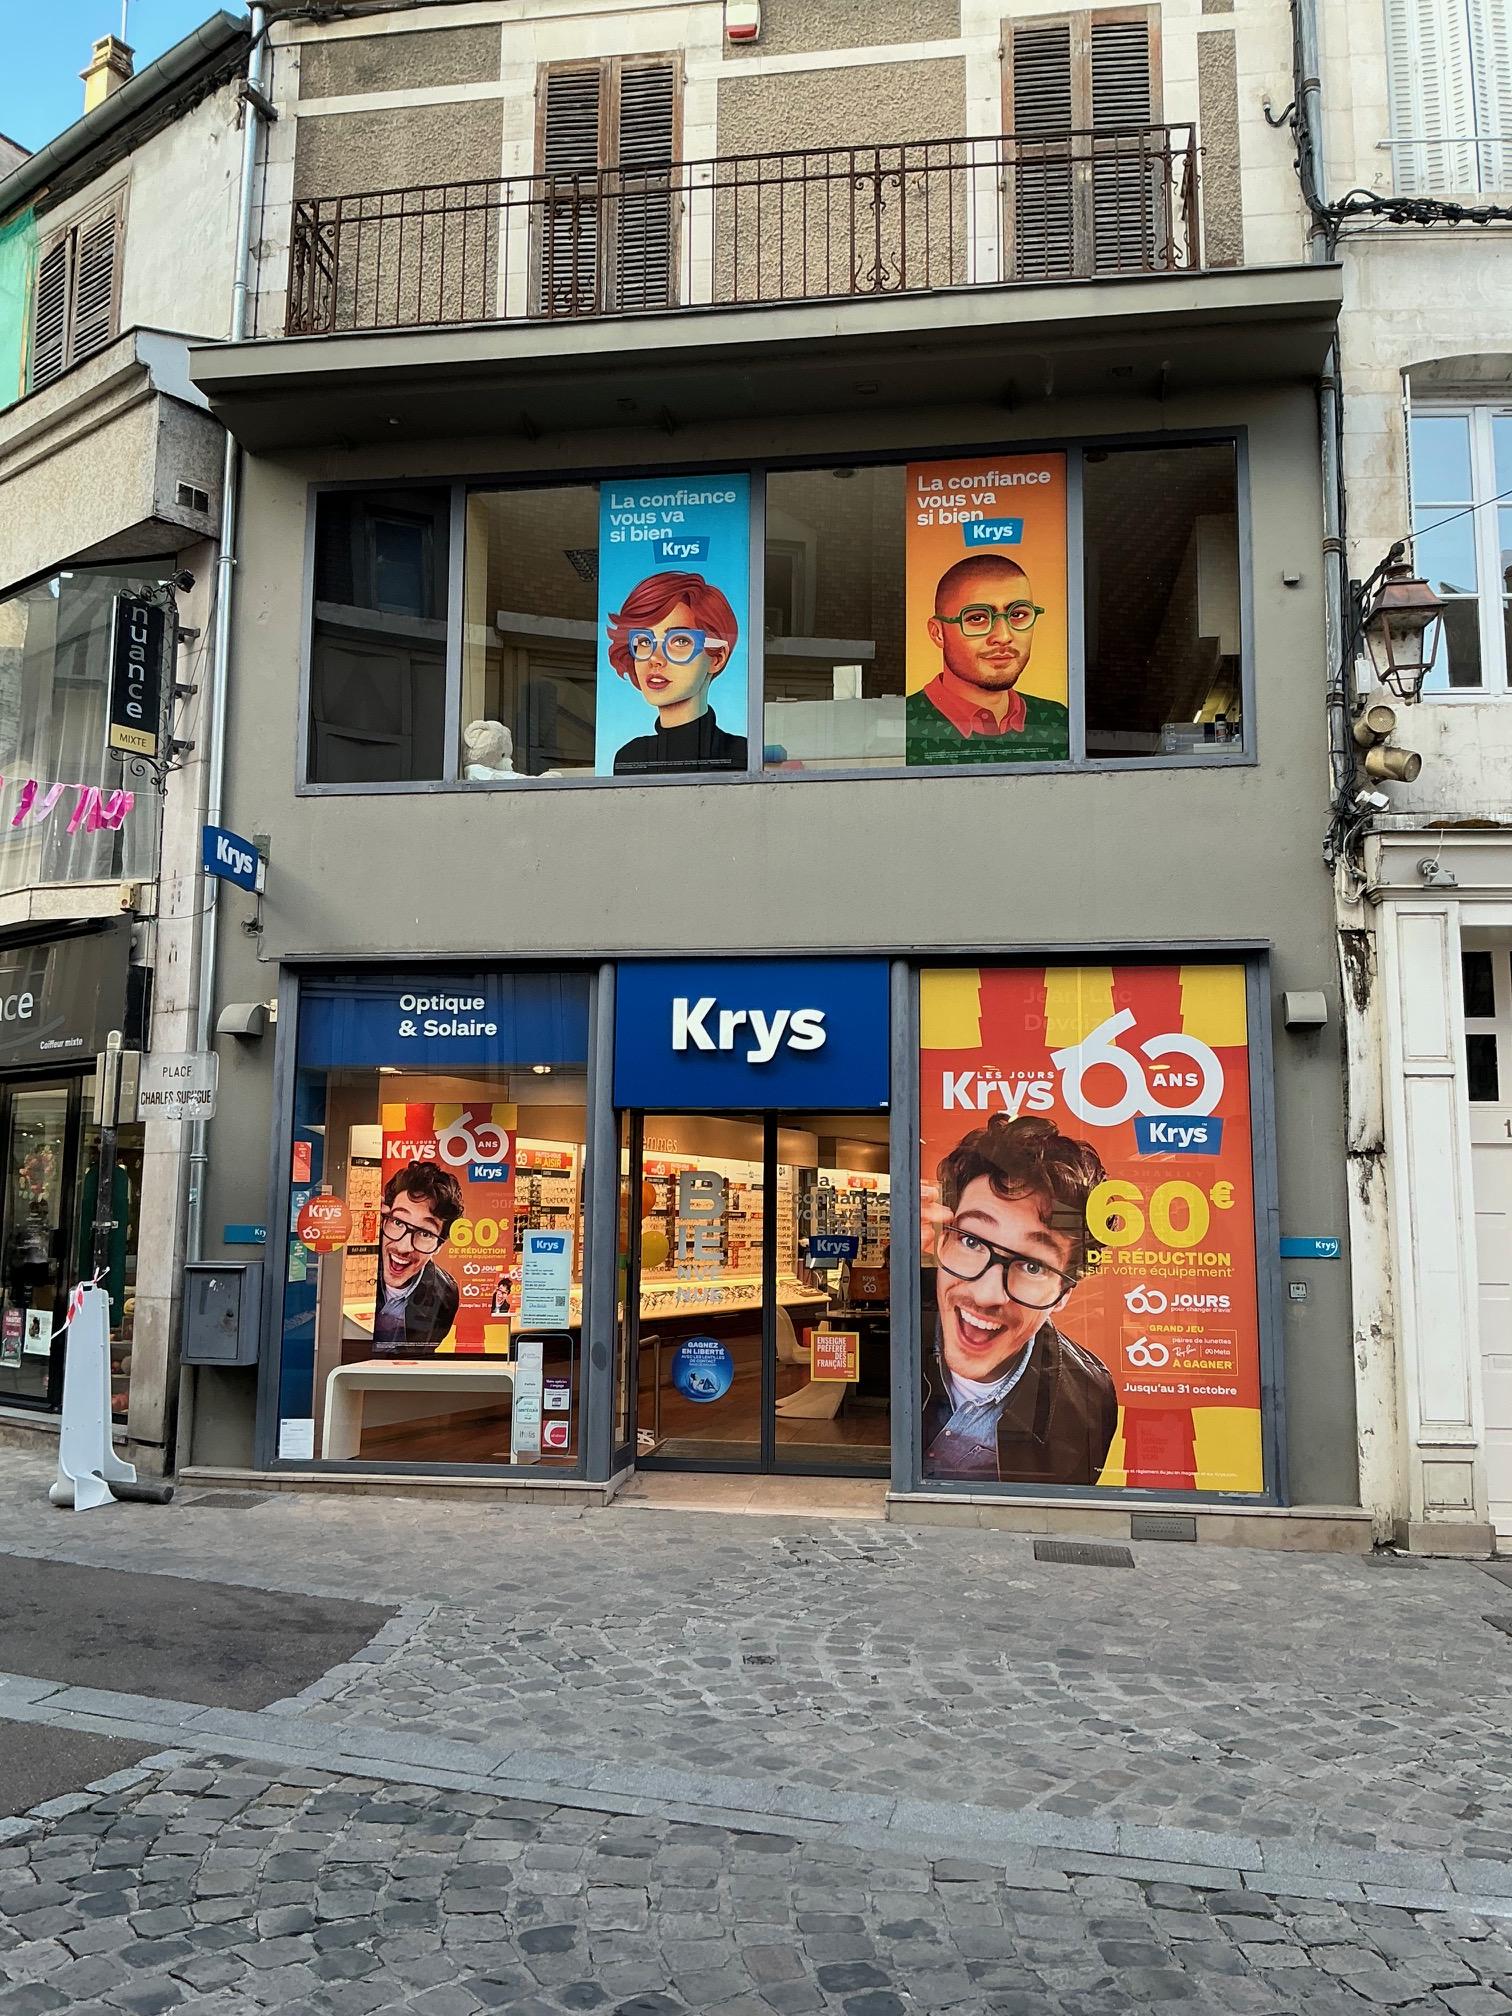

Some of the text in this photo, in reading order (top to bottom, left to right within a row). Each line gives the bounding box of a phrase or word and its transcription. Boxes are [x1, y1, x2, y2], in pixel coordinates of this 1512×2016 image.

[918, 471, 1051, 491] La confiance
[611, 490, 736, 509] La confiance
[917, 492, 996, 508] vous va
[610, 510, 685, 526] vous va
[917, 508, 984, 526] si bien
[610, 526, 673, 542] si bien
[973, 525, 1013, 540] Krys
[662, 542, 700, 558] Krys
[126, 605, 149, 719] nuance
[119, 733, 147, 748] MIXTE
[216, 835, 253, 875] Krys
[399, 994, 485, 1015] Optique
[398, 1019, 498, 1037] & Solaire
[672, 997, 827, 1063] Krys
[162, 1065, 192, 1078] PLACE
[1050, 1007, 1224, 1126] 60
[977, 1071, 1055, 1079] LES JOURS
[1152, 1073, 1199, 1088] ANS
[943, 1072, 1055, 1117] Krys
[435, 1111, 509, 1167] 60
[1150, 1122, 1208, 1147] Krys
[386, 1140, 437, 1161] Krys
[474, 1166, 503, 1178] Krys
[309, 1205, 342, 1221] Krys
[536, 1240, 559, 1250] Krys
[817, 1240, 850, 1255] Krys
[1316, 1240, 1336, 1251] Krys
[1087, 1248, 1231, 1266] DE RÉDUCTION
[463, 1262, 480, 1275] 60
[1087, 1266, 1109, 1275] sur
[1112, 1267, 1147, 1275] votre
[463, 1283, 480, 1297] 60
[1124, 1284, 1168, 1314] 60
[1171, 1294, 1231, 1308] JOURS
[1149, 1324, 1204, 1333] GRAND JEU
[1125, 1336, 1170, 1367] 60
[1173, 1359, 1181, 1368] À
[1123, 1383, 1237, 1396] Jusqu'au 31 octobre
